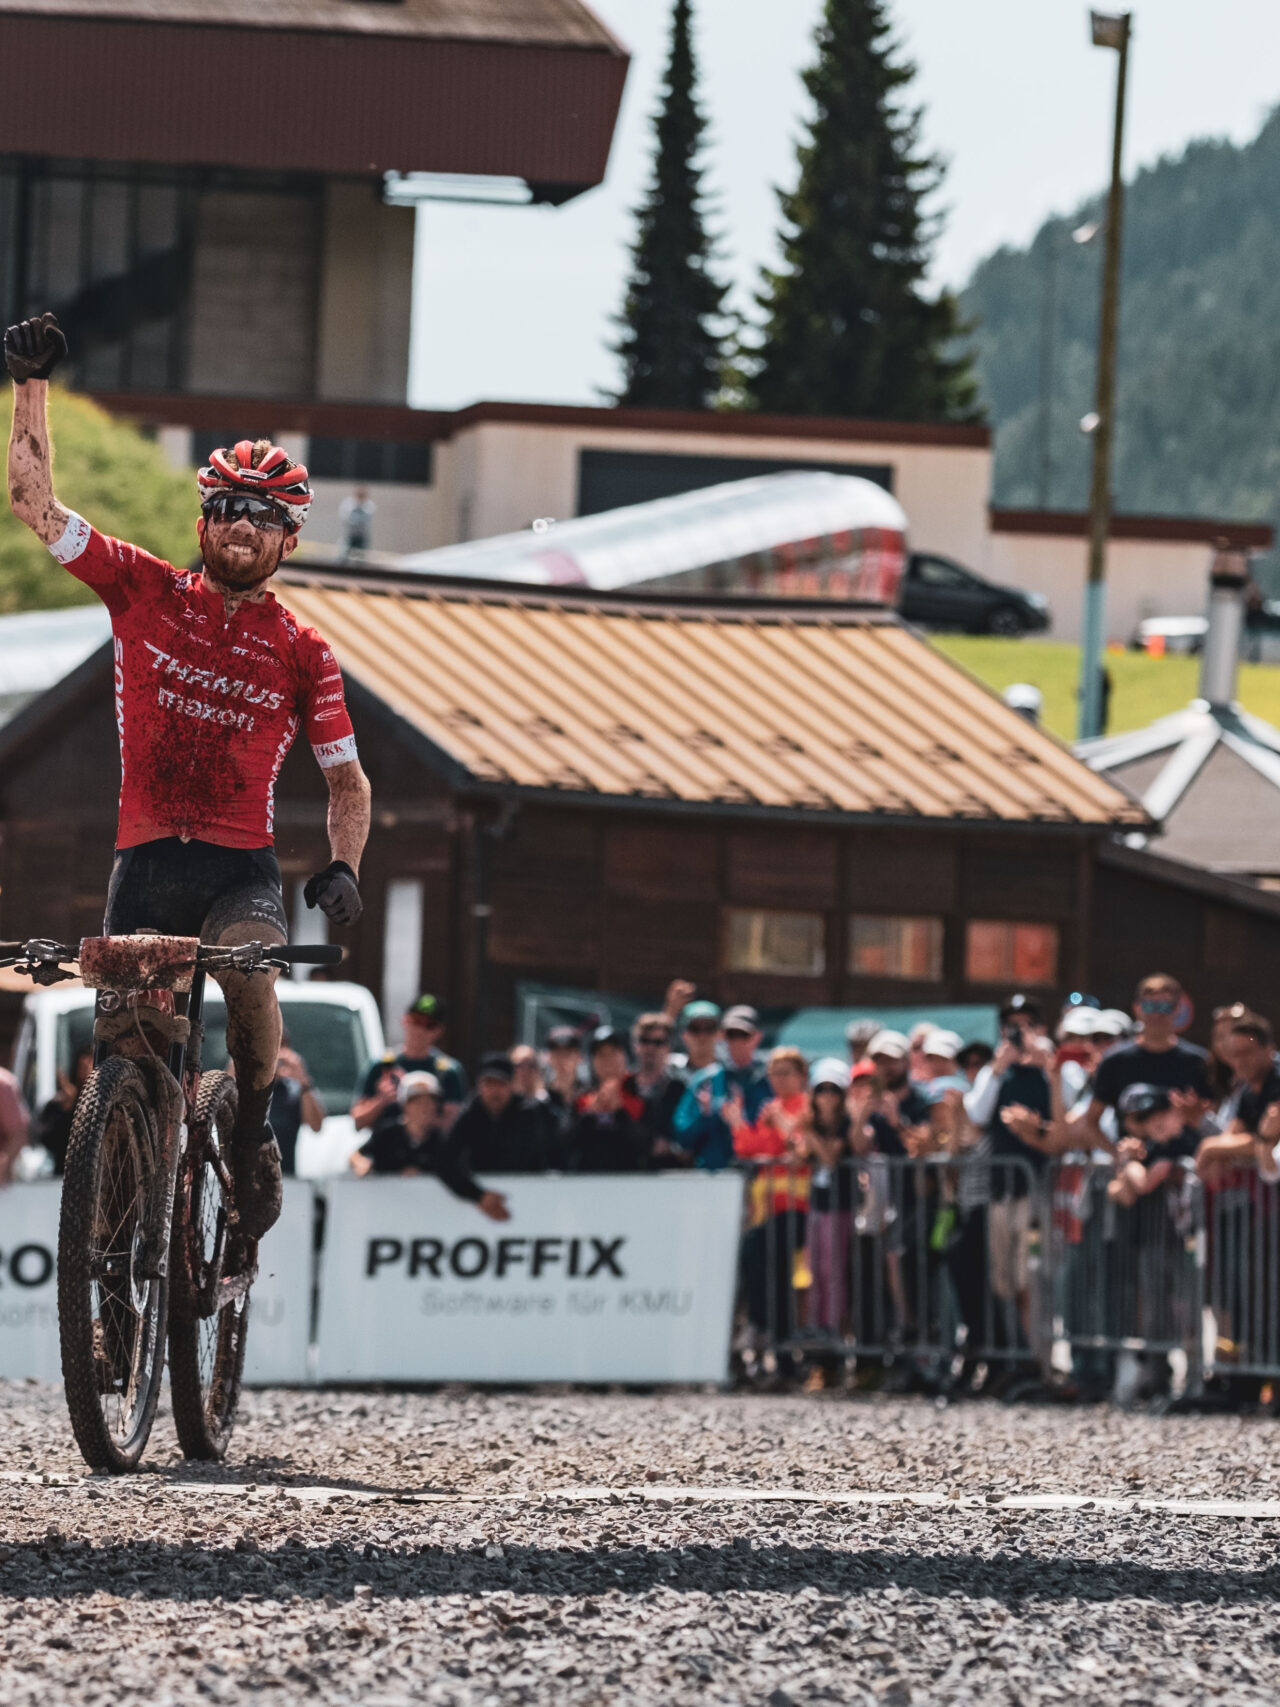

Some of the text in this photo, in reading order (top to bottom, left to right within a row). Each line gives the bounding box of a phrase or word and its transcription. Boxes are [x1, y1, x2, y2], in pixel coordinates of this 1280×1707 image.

[157, 687, 255, 732] maxon
[365, 1237, 626, 1279] PROFFIX
[421, 1287, 693, 1317] Software für KMU
